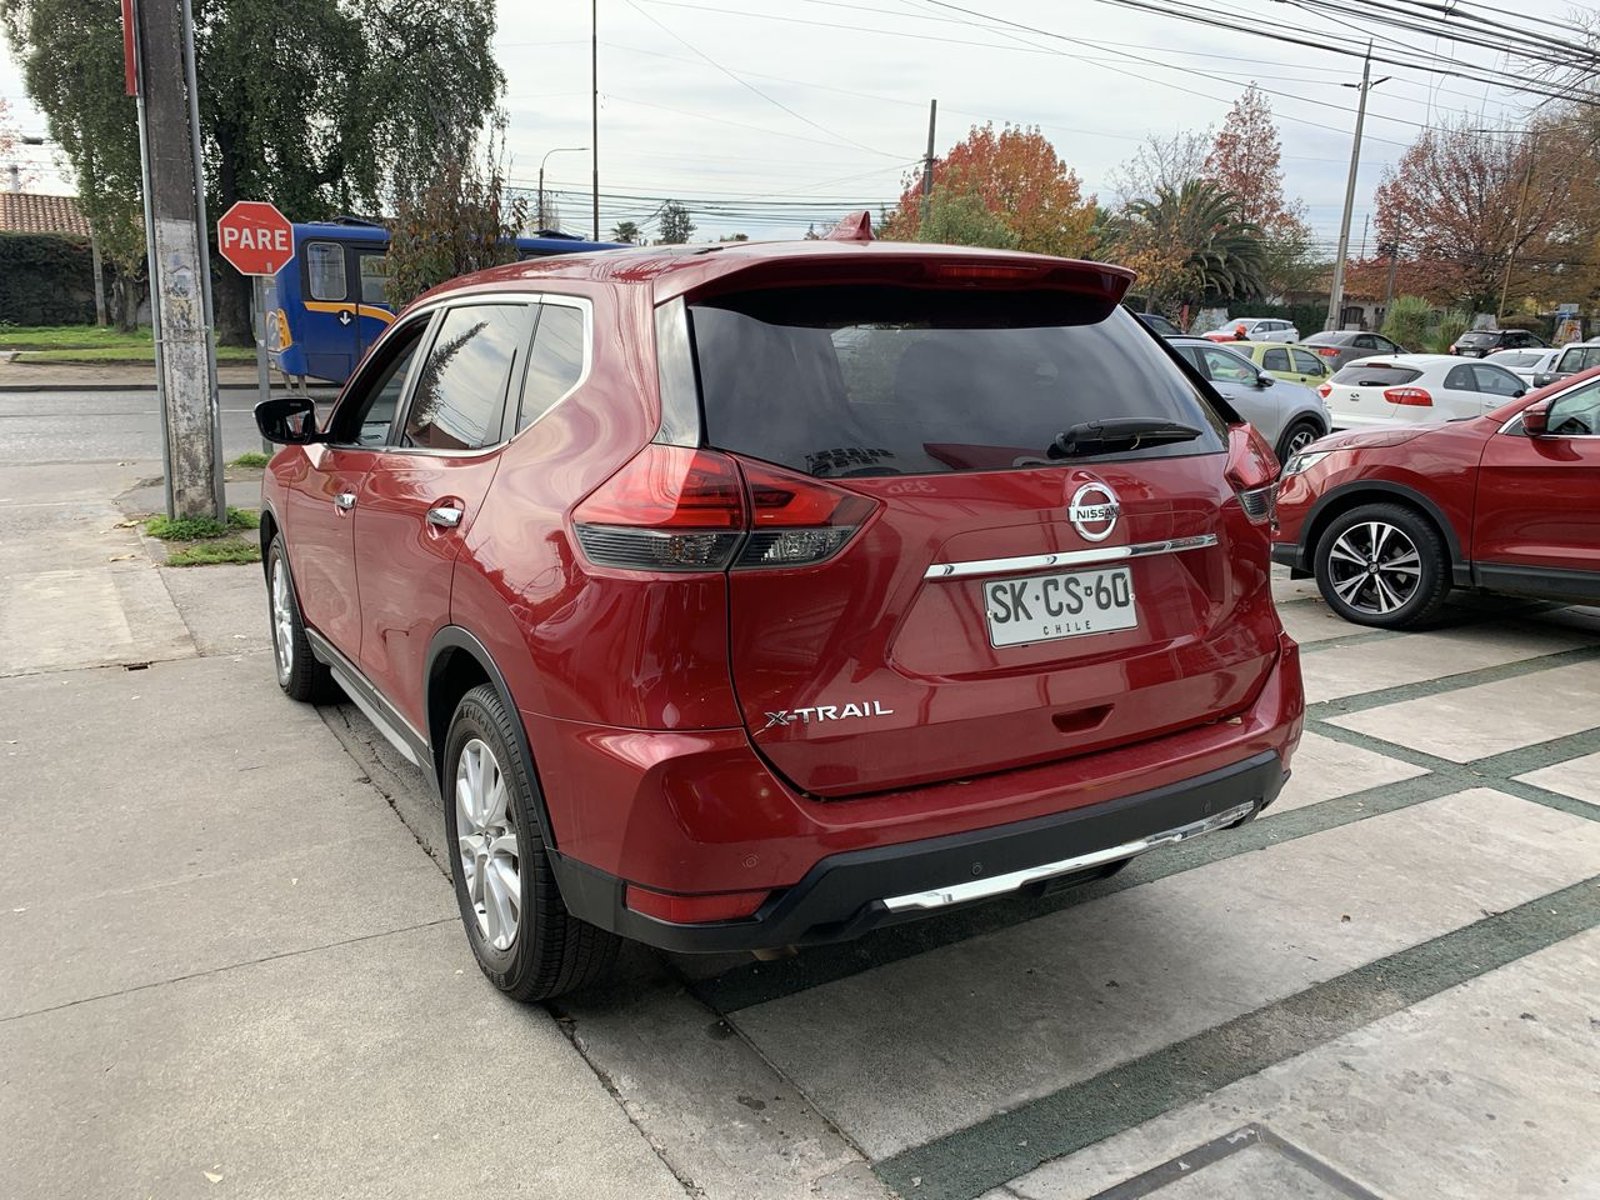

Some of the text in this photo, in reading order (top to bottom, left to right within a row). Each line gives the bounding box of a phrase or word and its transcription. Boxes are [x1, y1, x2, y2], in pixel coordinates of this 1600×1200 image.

[223, 227, 289, 251] PARE
[1077, 504, 1119, 519] NISSAN
[1043, 620, 1091, 635] CHILE
[764, 700, 894, 728] X-TRAIL
